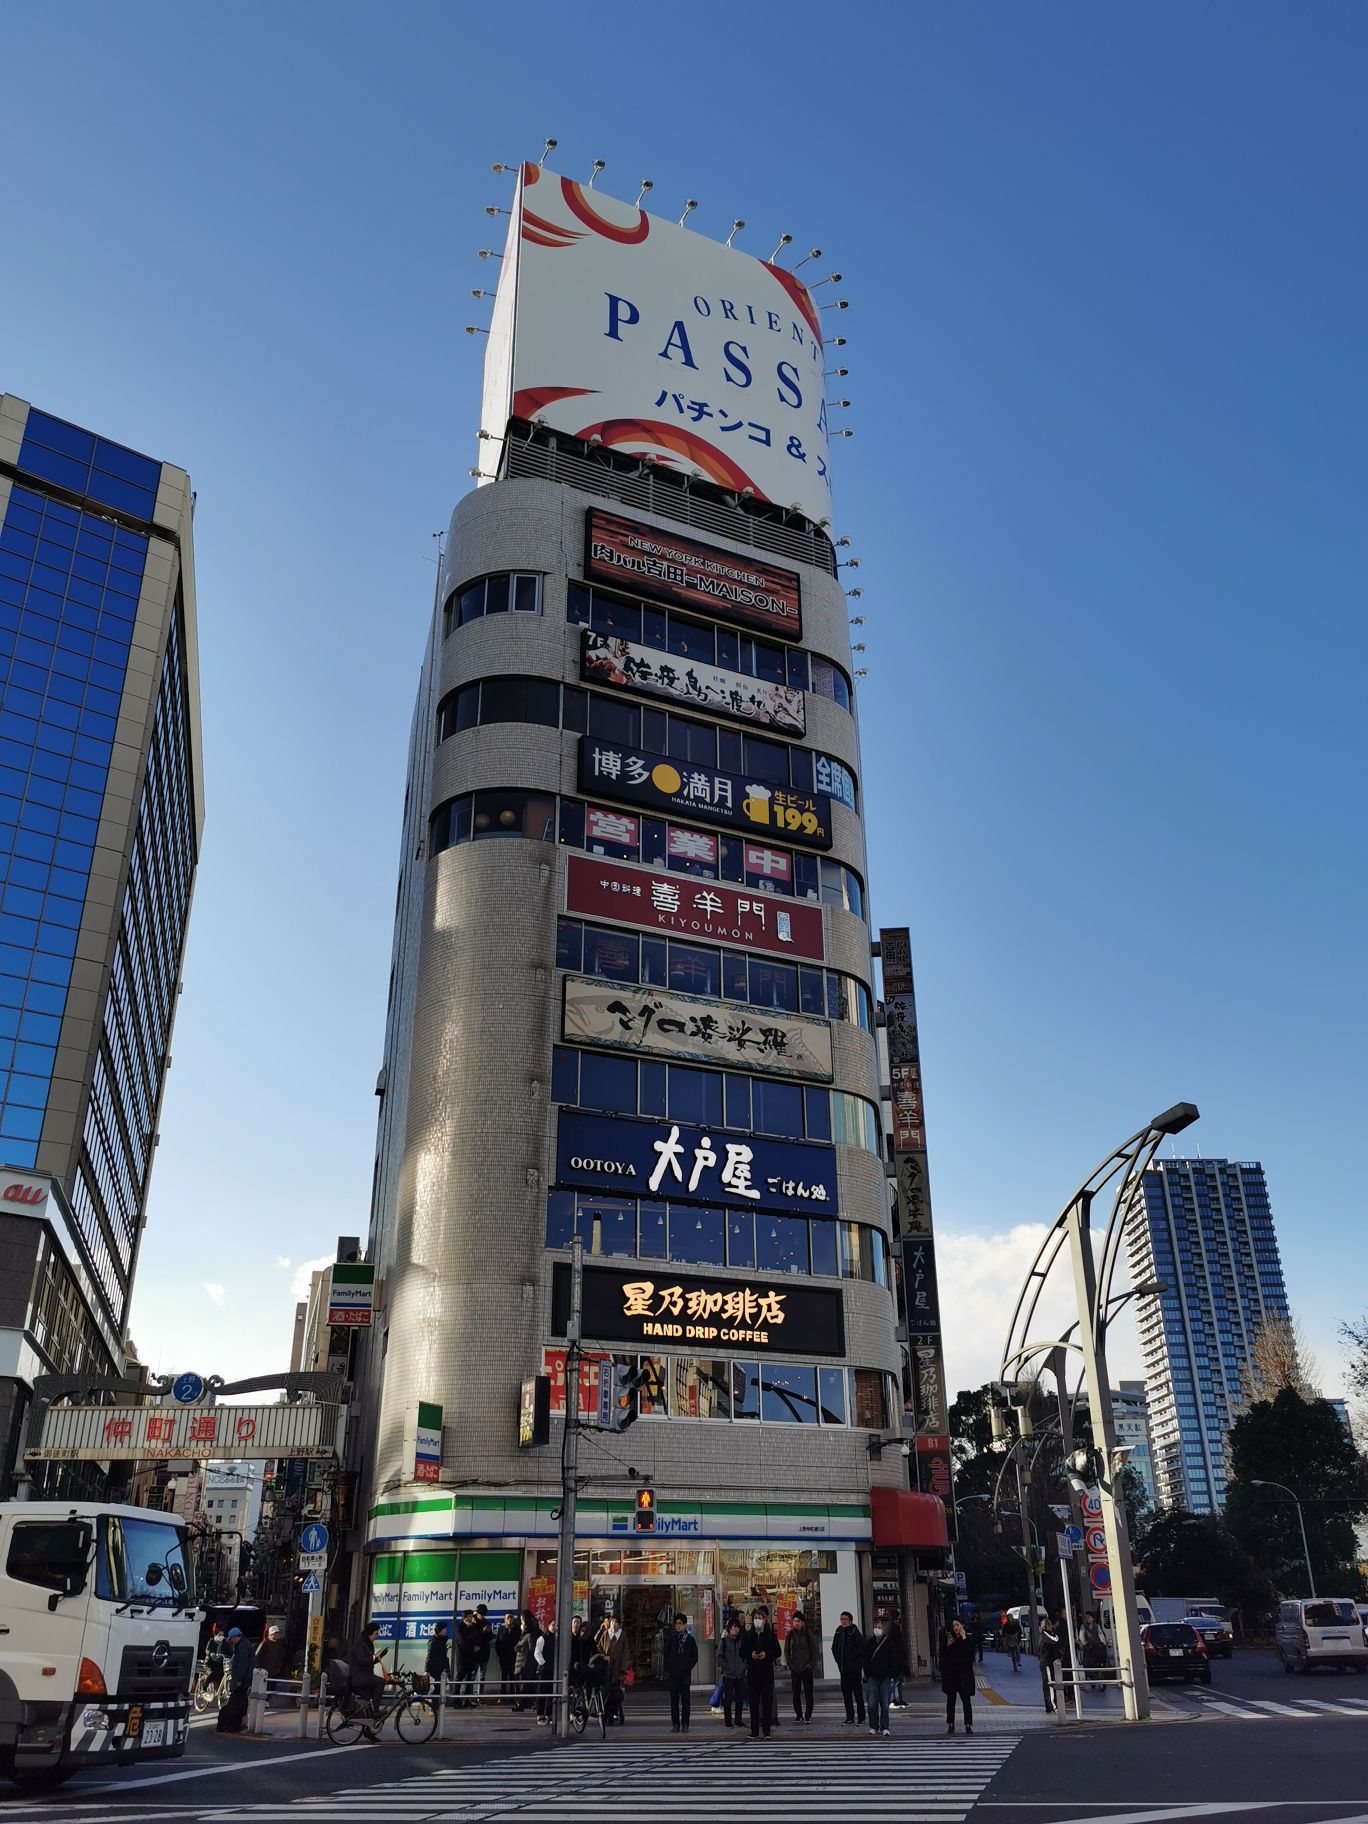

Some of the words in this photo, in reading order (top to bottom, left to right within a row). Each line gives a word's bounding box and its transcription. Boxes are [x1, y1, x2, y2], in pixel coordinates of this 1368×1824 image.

[655, 389, 772, 448] パチンコ
[786, 435, 808, 464] &
[628, 535, 664, 555] NEW
[665, 546, 704, 568] YORK
[705, 556, 766, 588] KITCHEN
[586, 631, 605, 649] 7F
[671, 796, 697, 807] HAKATA
[698, 802, 733, 815] MANGETSU
[774, 789, 816, 811] 生ビール
[600, 878, 641, 896] 中国料理
[650, 880, 766, 931] 喜羊門
[658, 913, 754, 941] KIYOUMON
[892, 1068, 909, 1079] 5F
[896, 1091, 921, 1149] 喜羊門
[570, 1156, 637, 1176] OOTOYA
[649, 1125, 761, 1200] 大戸屋
[2, 1183, 49, 1205] au
[912, 1245, 931, 1310] 大戸屋
[332, 1289, 372, 1298] FamilyMart
[621, 1281, 788, 1329] 星乃珈琲店
[643, 1322, 683, 1337] HAND
[686, 1325, 718, 1340] DRIP
[720, 1328, 769, 1343] COFFEE
[916, 1348, 940, 1432] 星乃珈琲店
[105, 1416, 257, 1442] 仲町通り
[287, 1448, 314, 1458] 上野駅
[927, 1437, 939, 1449] B1
[1088, 1499, 1101, 1511] 40
[403, 1590, 453, 1604] FamilyMart
[459, 1589, 517, 1603] FamilyMart
[126, 1706, 142, 1736] 危
